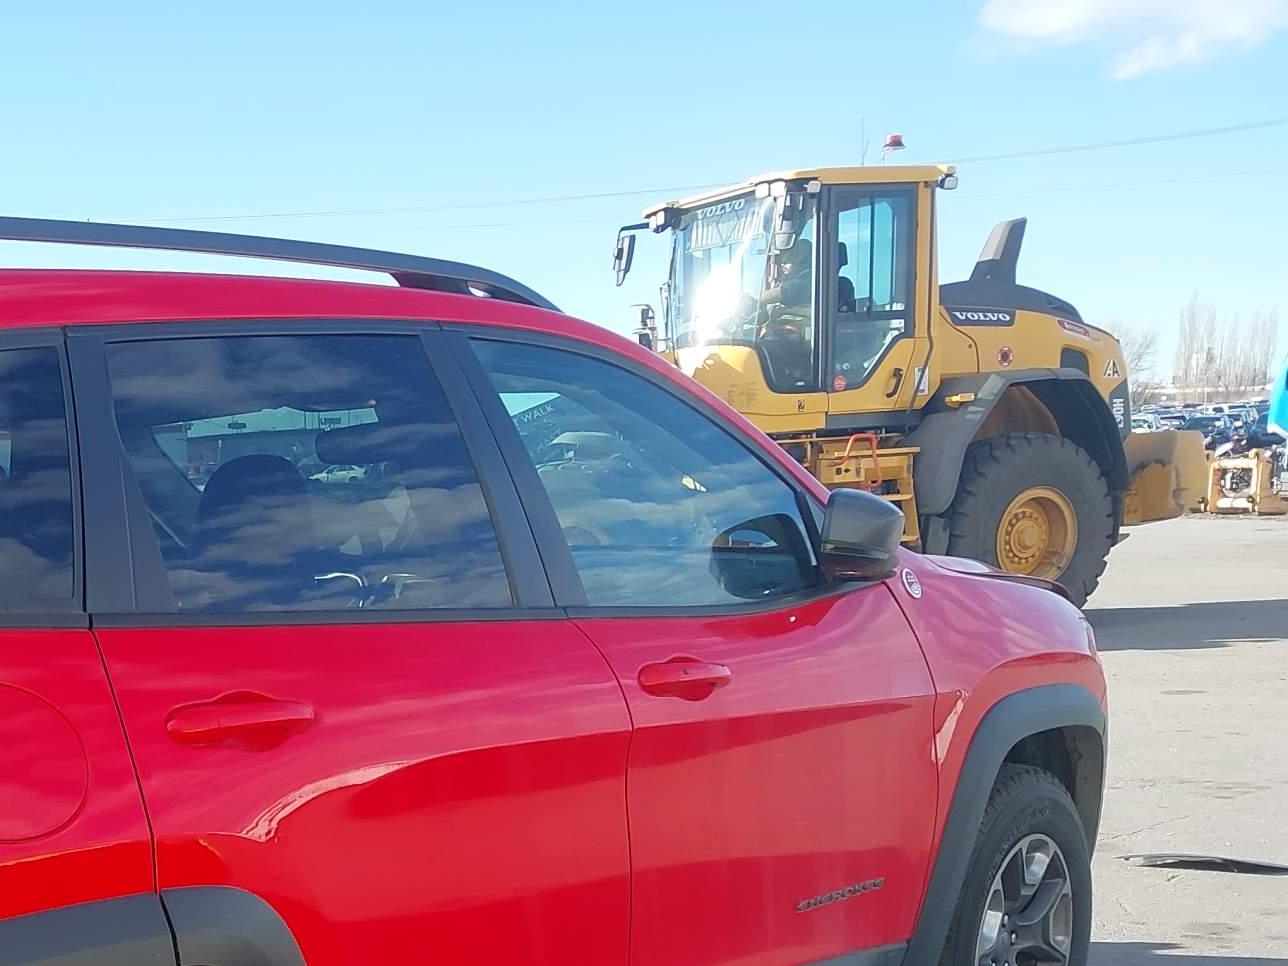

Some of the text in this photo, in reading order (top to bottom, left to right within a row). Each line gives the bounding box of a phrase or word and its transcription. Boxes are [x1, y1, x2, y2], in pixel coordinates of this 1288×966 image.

[696, 199, 745, 219] VOLVO
[952, 311, 1011, 321] VOLVO
[521, 403, 555, 423] WALK
